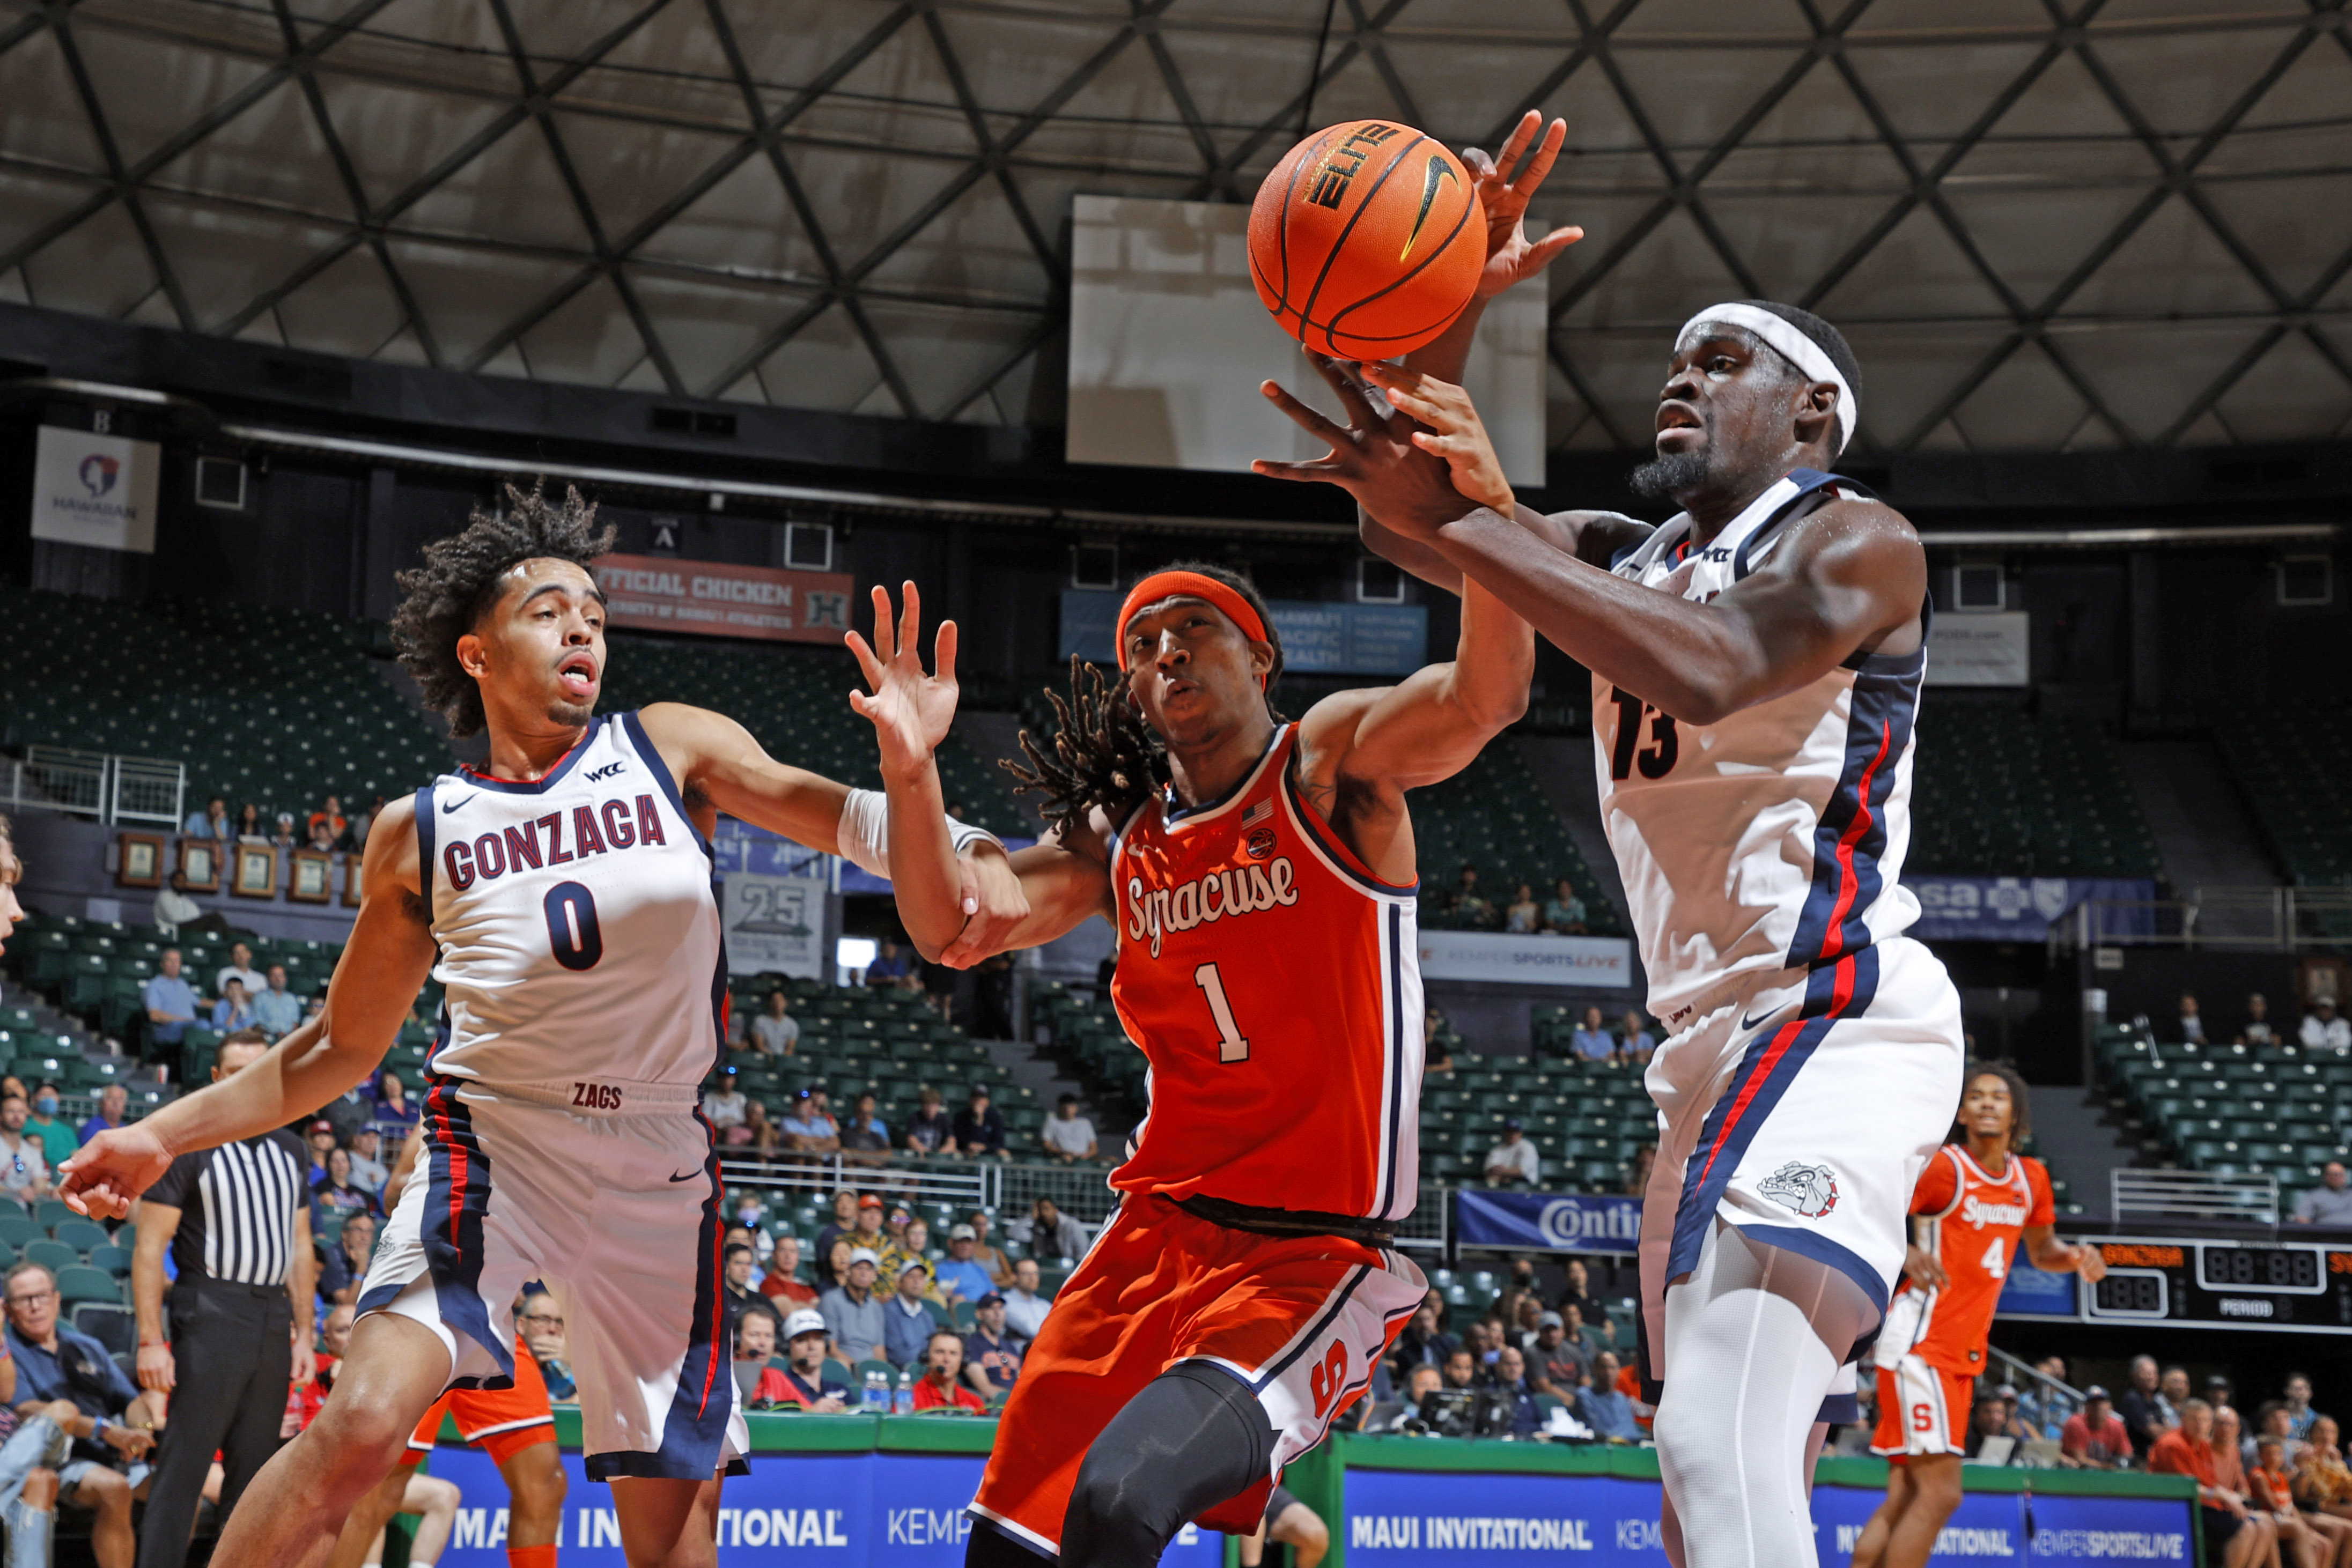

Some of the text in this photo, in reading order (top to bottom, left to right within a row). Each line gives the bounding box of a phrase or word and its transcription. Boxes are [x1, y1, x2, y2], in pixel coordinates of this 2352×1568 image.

[1309, 123, 1401, 210] ELITE
[53, 495, 137, 519] HAWAIIAN
[654, 526, 674, 548] A
[596, 567, 792, 607] FFICIAL CHICKEN
[803, 591, 849, 631] H
[1284, 647, 1341, 665] EALTH
[1610, 685, 1679, 781] 13
[583, 761, 626, 783] WCC
[444, 794, 667, 891] GONZAGA
[741, 883, 806, 925] 25
[1128, 856, 1299, 959] Syracuse
[1911, 882, 1980, 907] sa
[543, 881, 603, 971] 0
[1193, 961, 1249, 1064] 1
[572, 1082, 622, 1110] ZAGS
[1980, 1236, 2004, 1279] 4
[2219, 1298, 2274, 1317] PERIOD
[1310, 1338, 1348, 1420] S
[1913, 1403, 1933, 1432] S
[1351, 1516, 1593, 1550] MAUI INVITATIONAL
[1932, 1527, 2014, 1556] ATIONAL
